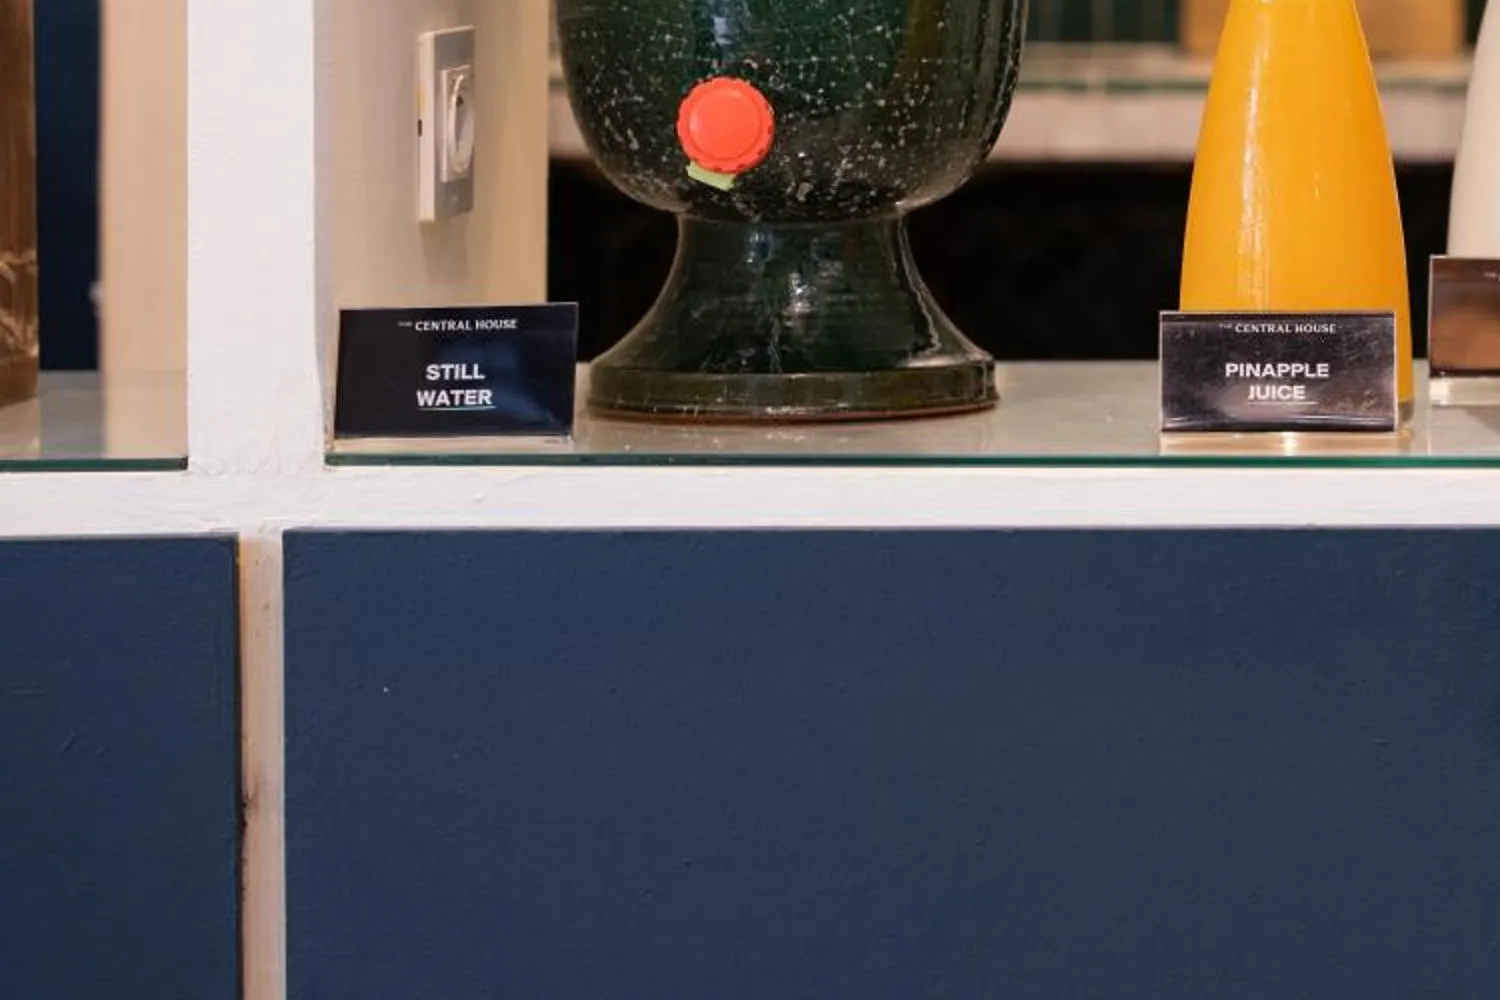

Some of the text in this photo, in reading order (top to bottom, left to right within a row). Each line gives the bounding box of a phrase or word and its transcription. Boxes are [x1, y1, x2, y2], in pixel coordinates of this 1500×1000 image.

[415, 319, 472, 331] CENTRAL
[475, 318, 518, 329] HOUSE
[1235, 323, 1292, 333] CENTRAL
[1295, 323, 1336, 333] HOUSE
[426, 363, 485, 381] STILL
[1225, 363, 1329, 378] PINAPPLE
[416, 389, 493, 407] WATER
[1248, 385, 1306, 400] JUICE
